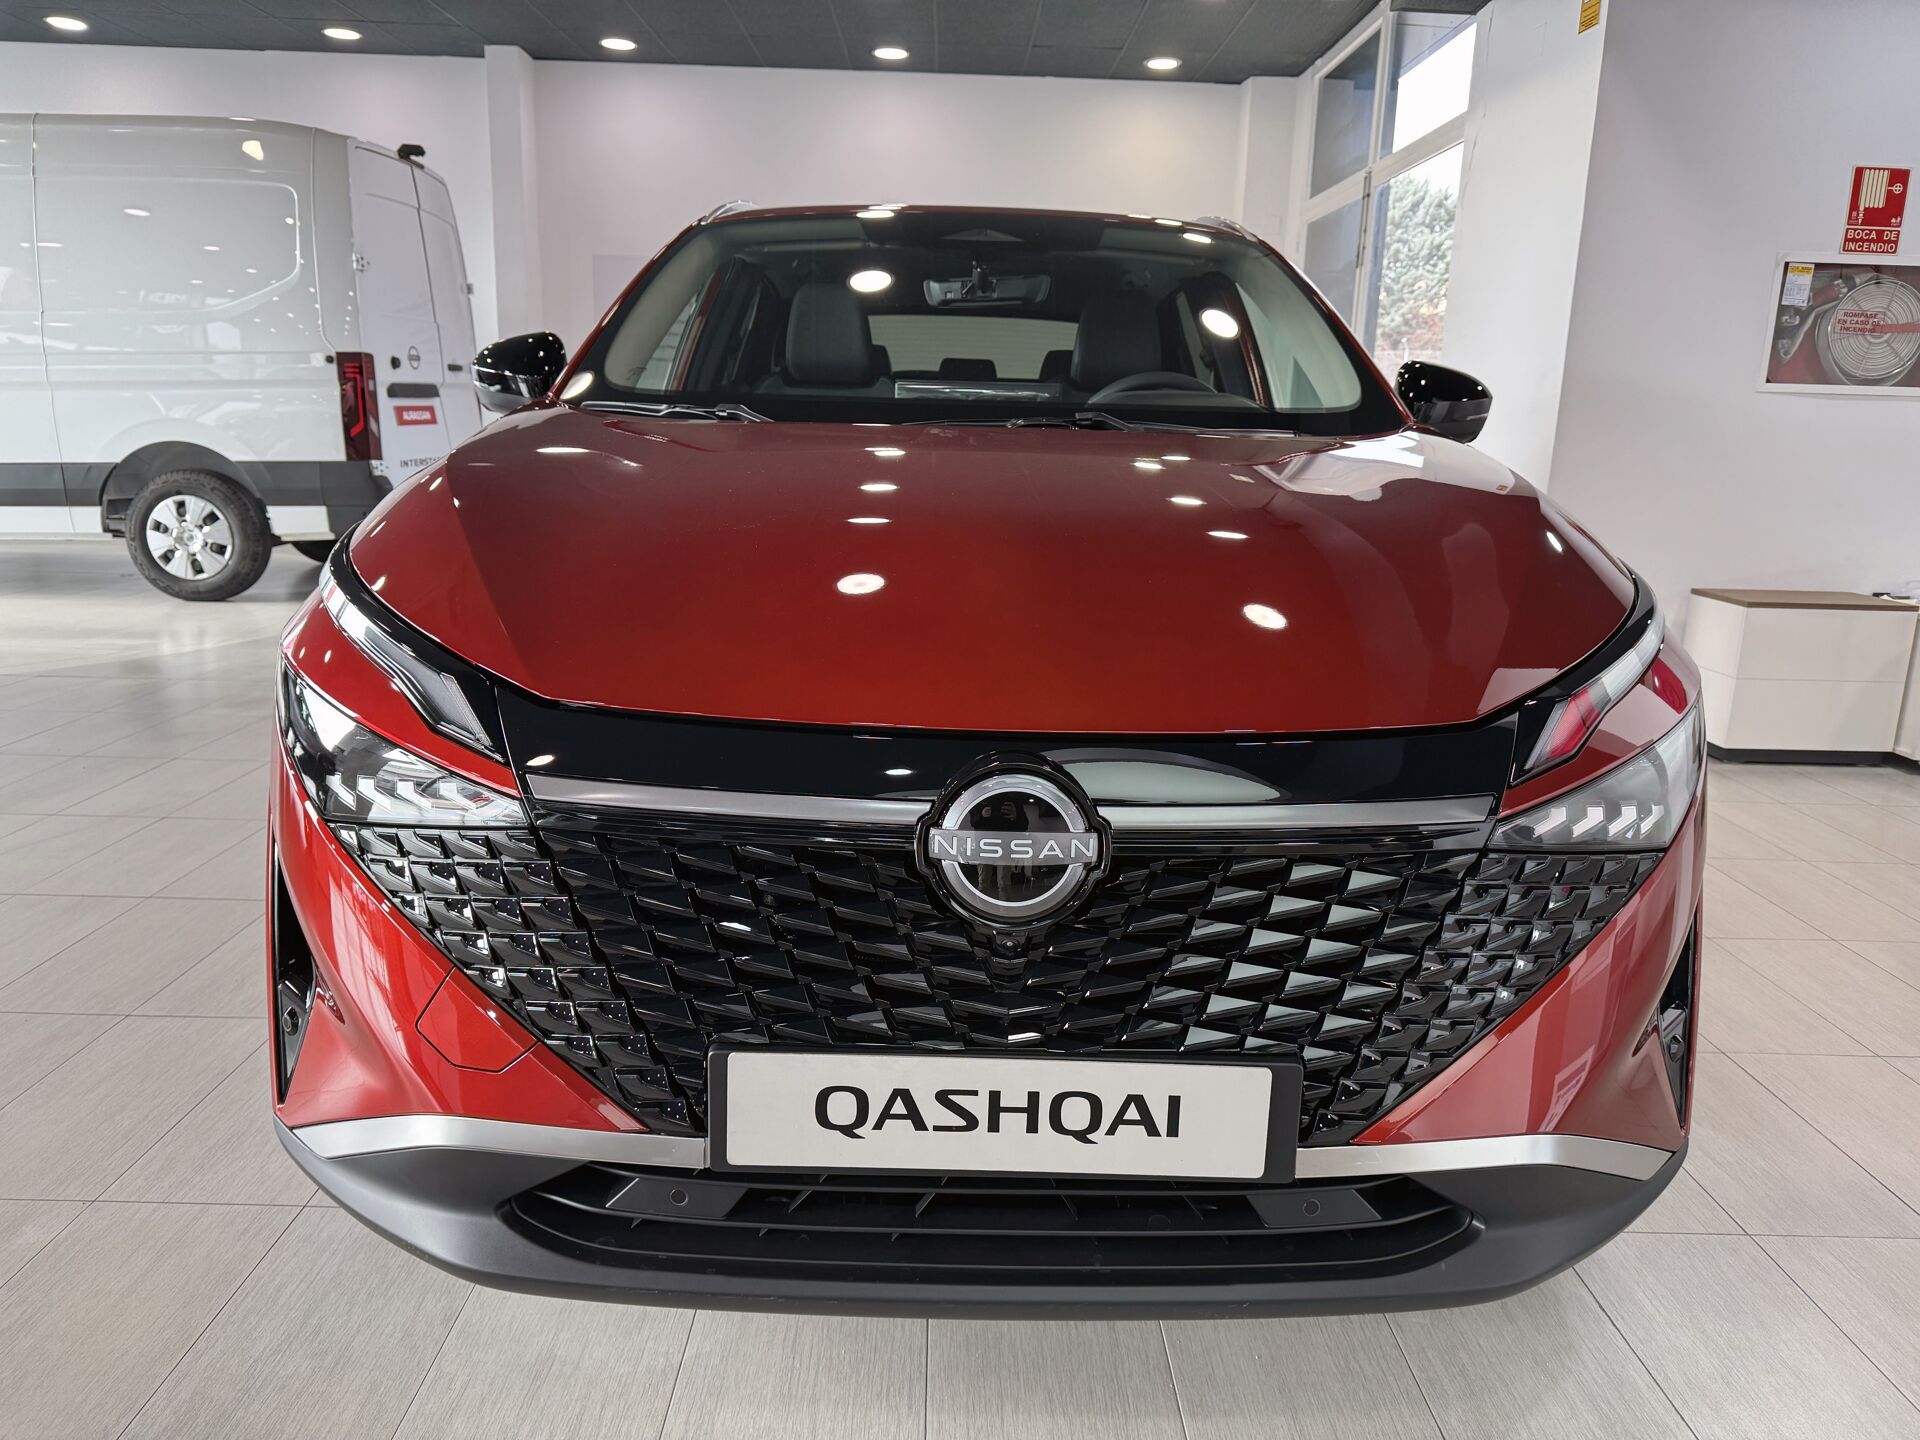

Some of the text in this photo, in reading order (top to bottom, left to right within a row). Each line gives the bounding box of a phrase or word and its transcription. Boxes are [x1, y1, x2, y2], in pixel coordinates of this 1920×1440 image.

[1847, 229, 1898, 241] BOCA DE
[1844, 241, 1896, 253] INCENDIO
[1843, 311, 1879, 319] ROMPASE
[399, 456, 442, 468] INTERST
[933, 834, 1094, 859] NISSAN
[814, 1085, 1181, 1144] QASHQAI
